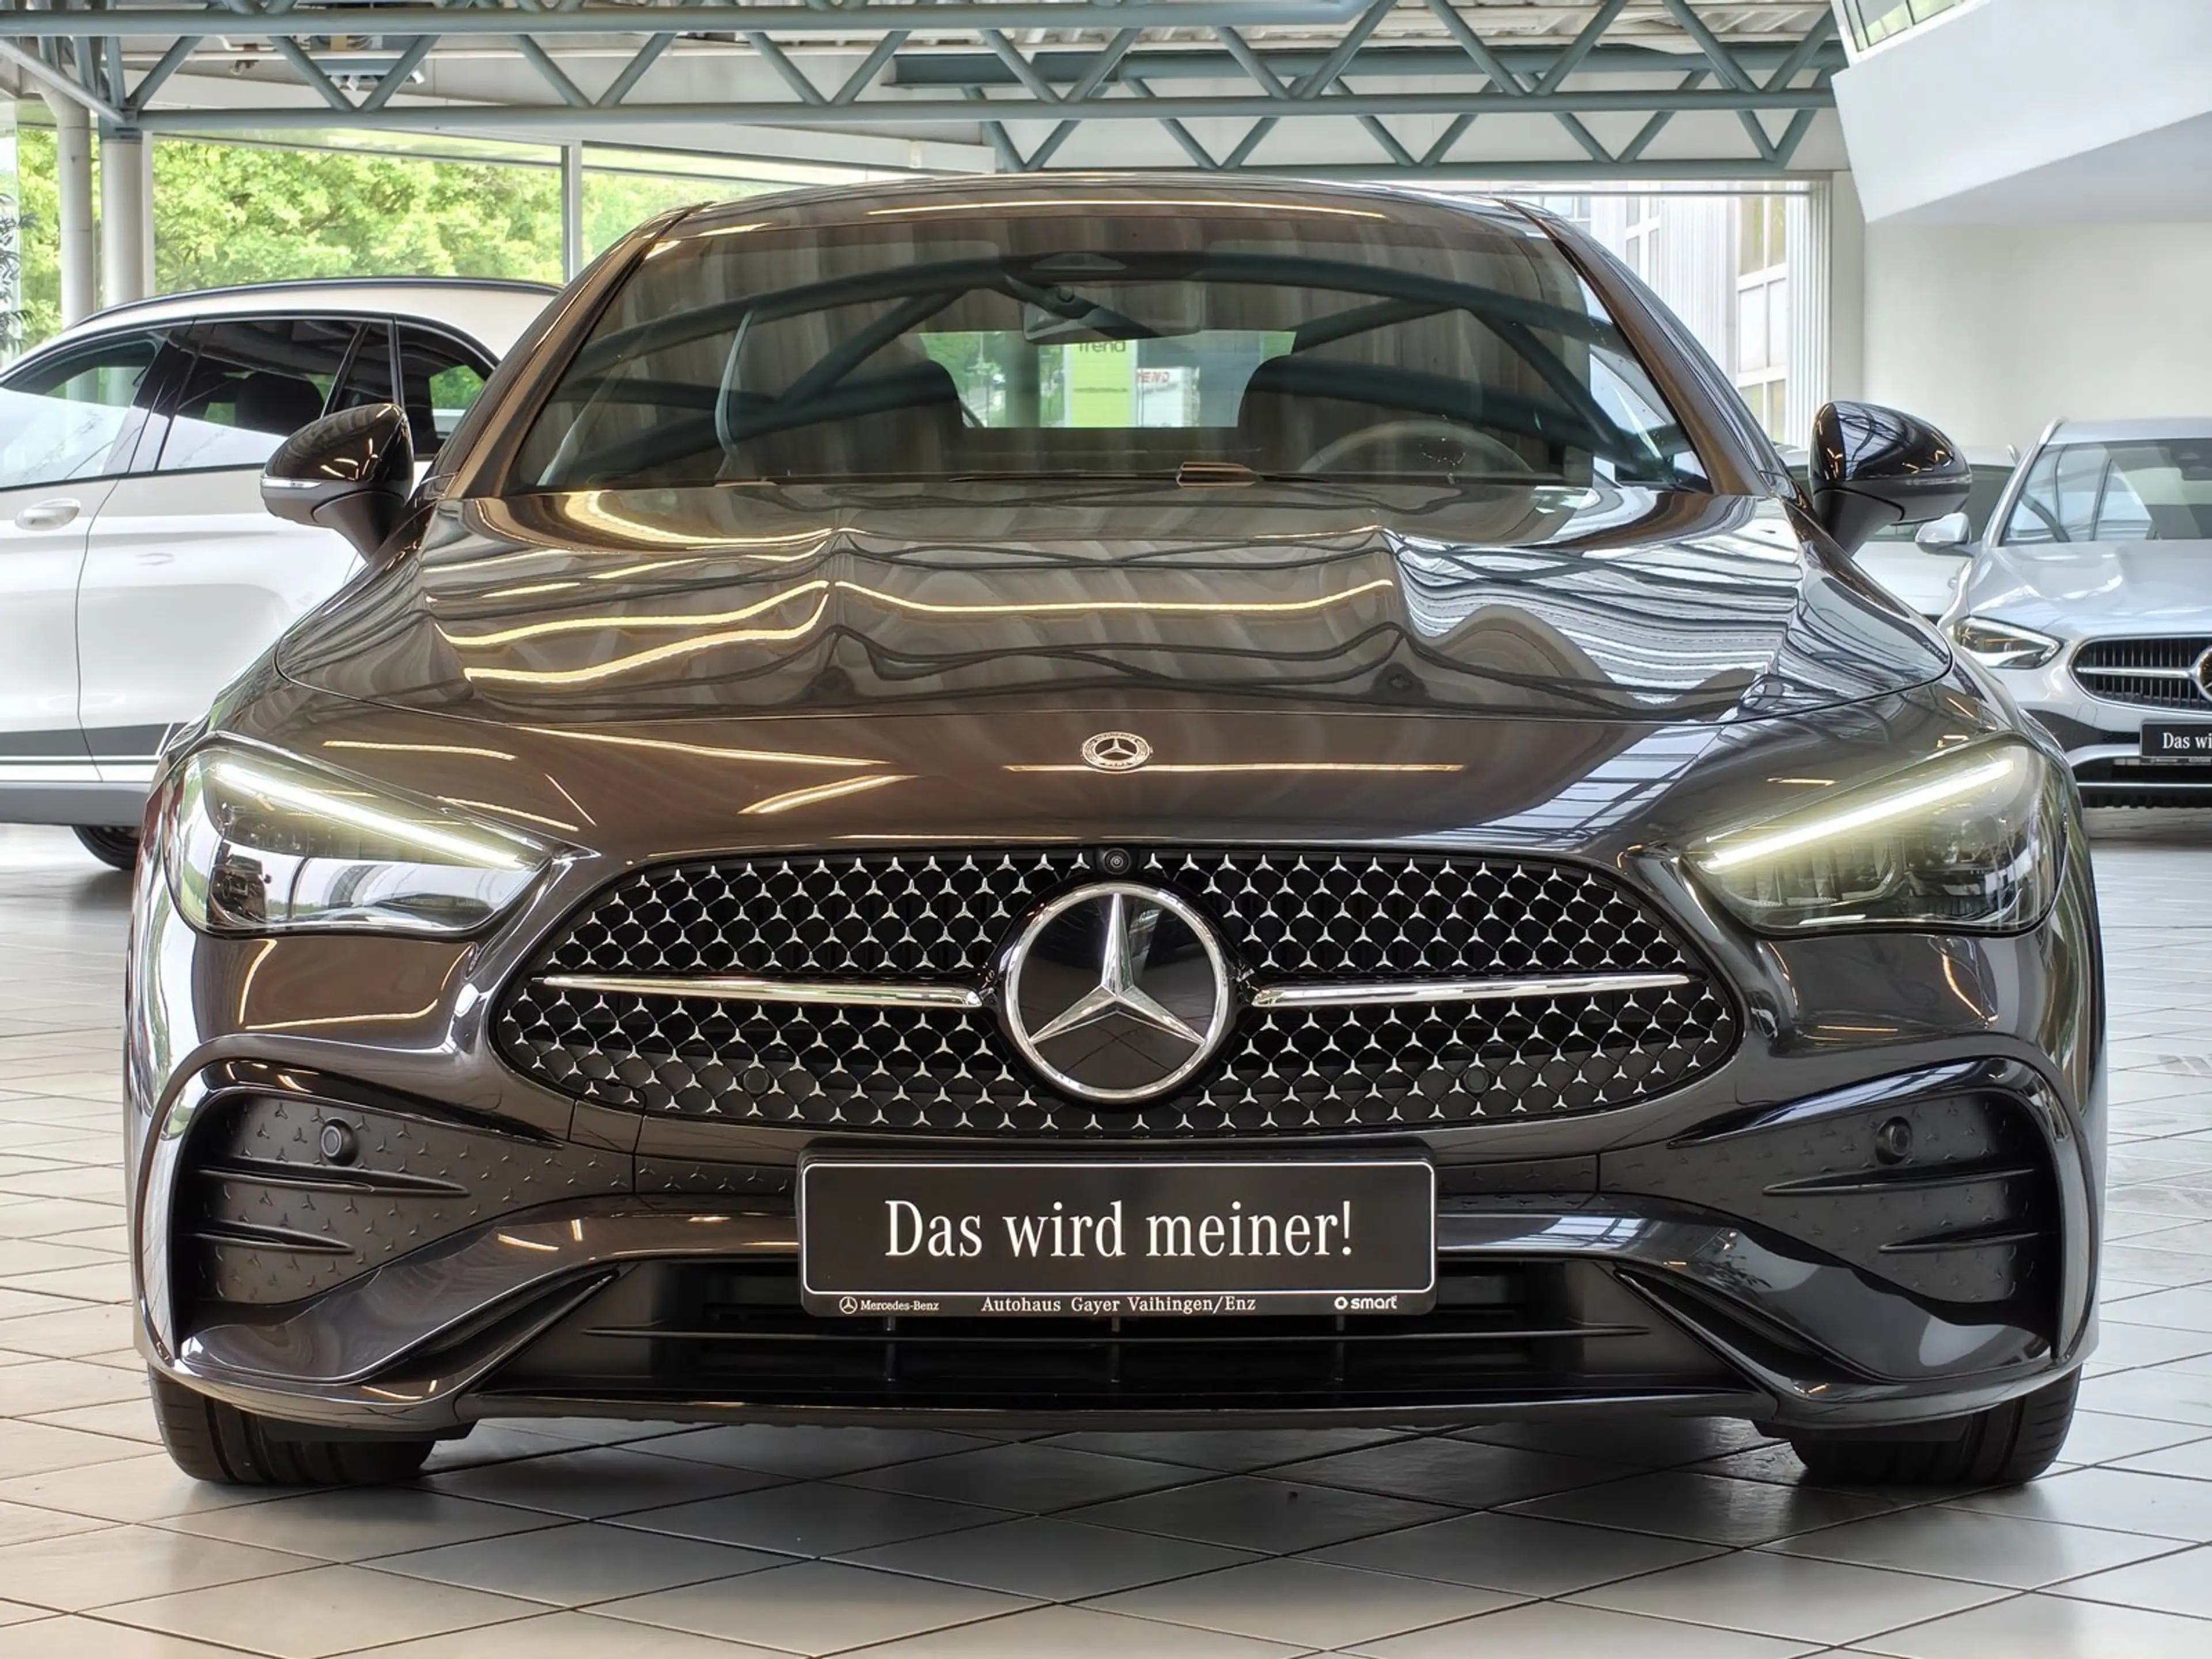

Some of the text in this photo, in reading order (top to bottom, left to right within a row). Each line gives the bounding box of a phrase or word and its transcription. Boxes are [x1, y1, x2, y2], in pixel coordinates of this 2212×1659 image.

[2162, 732, 2190, 749] Das
[885, 1200, 1351, 1257] Das wird meiner!
[860, 1300, 940, 1311] Mercedes-Benz
[980, 1296, 1256, 1315] Autohaus Gayer Vaihingen/Enz
[1350, 1295, 1397, 1309] smart
